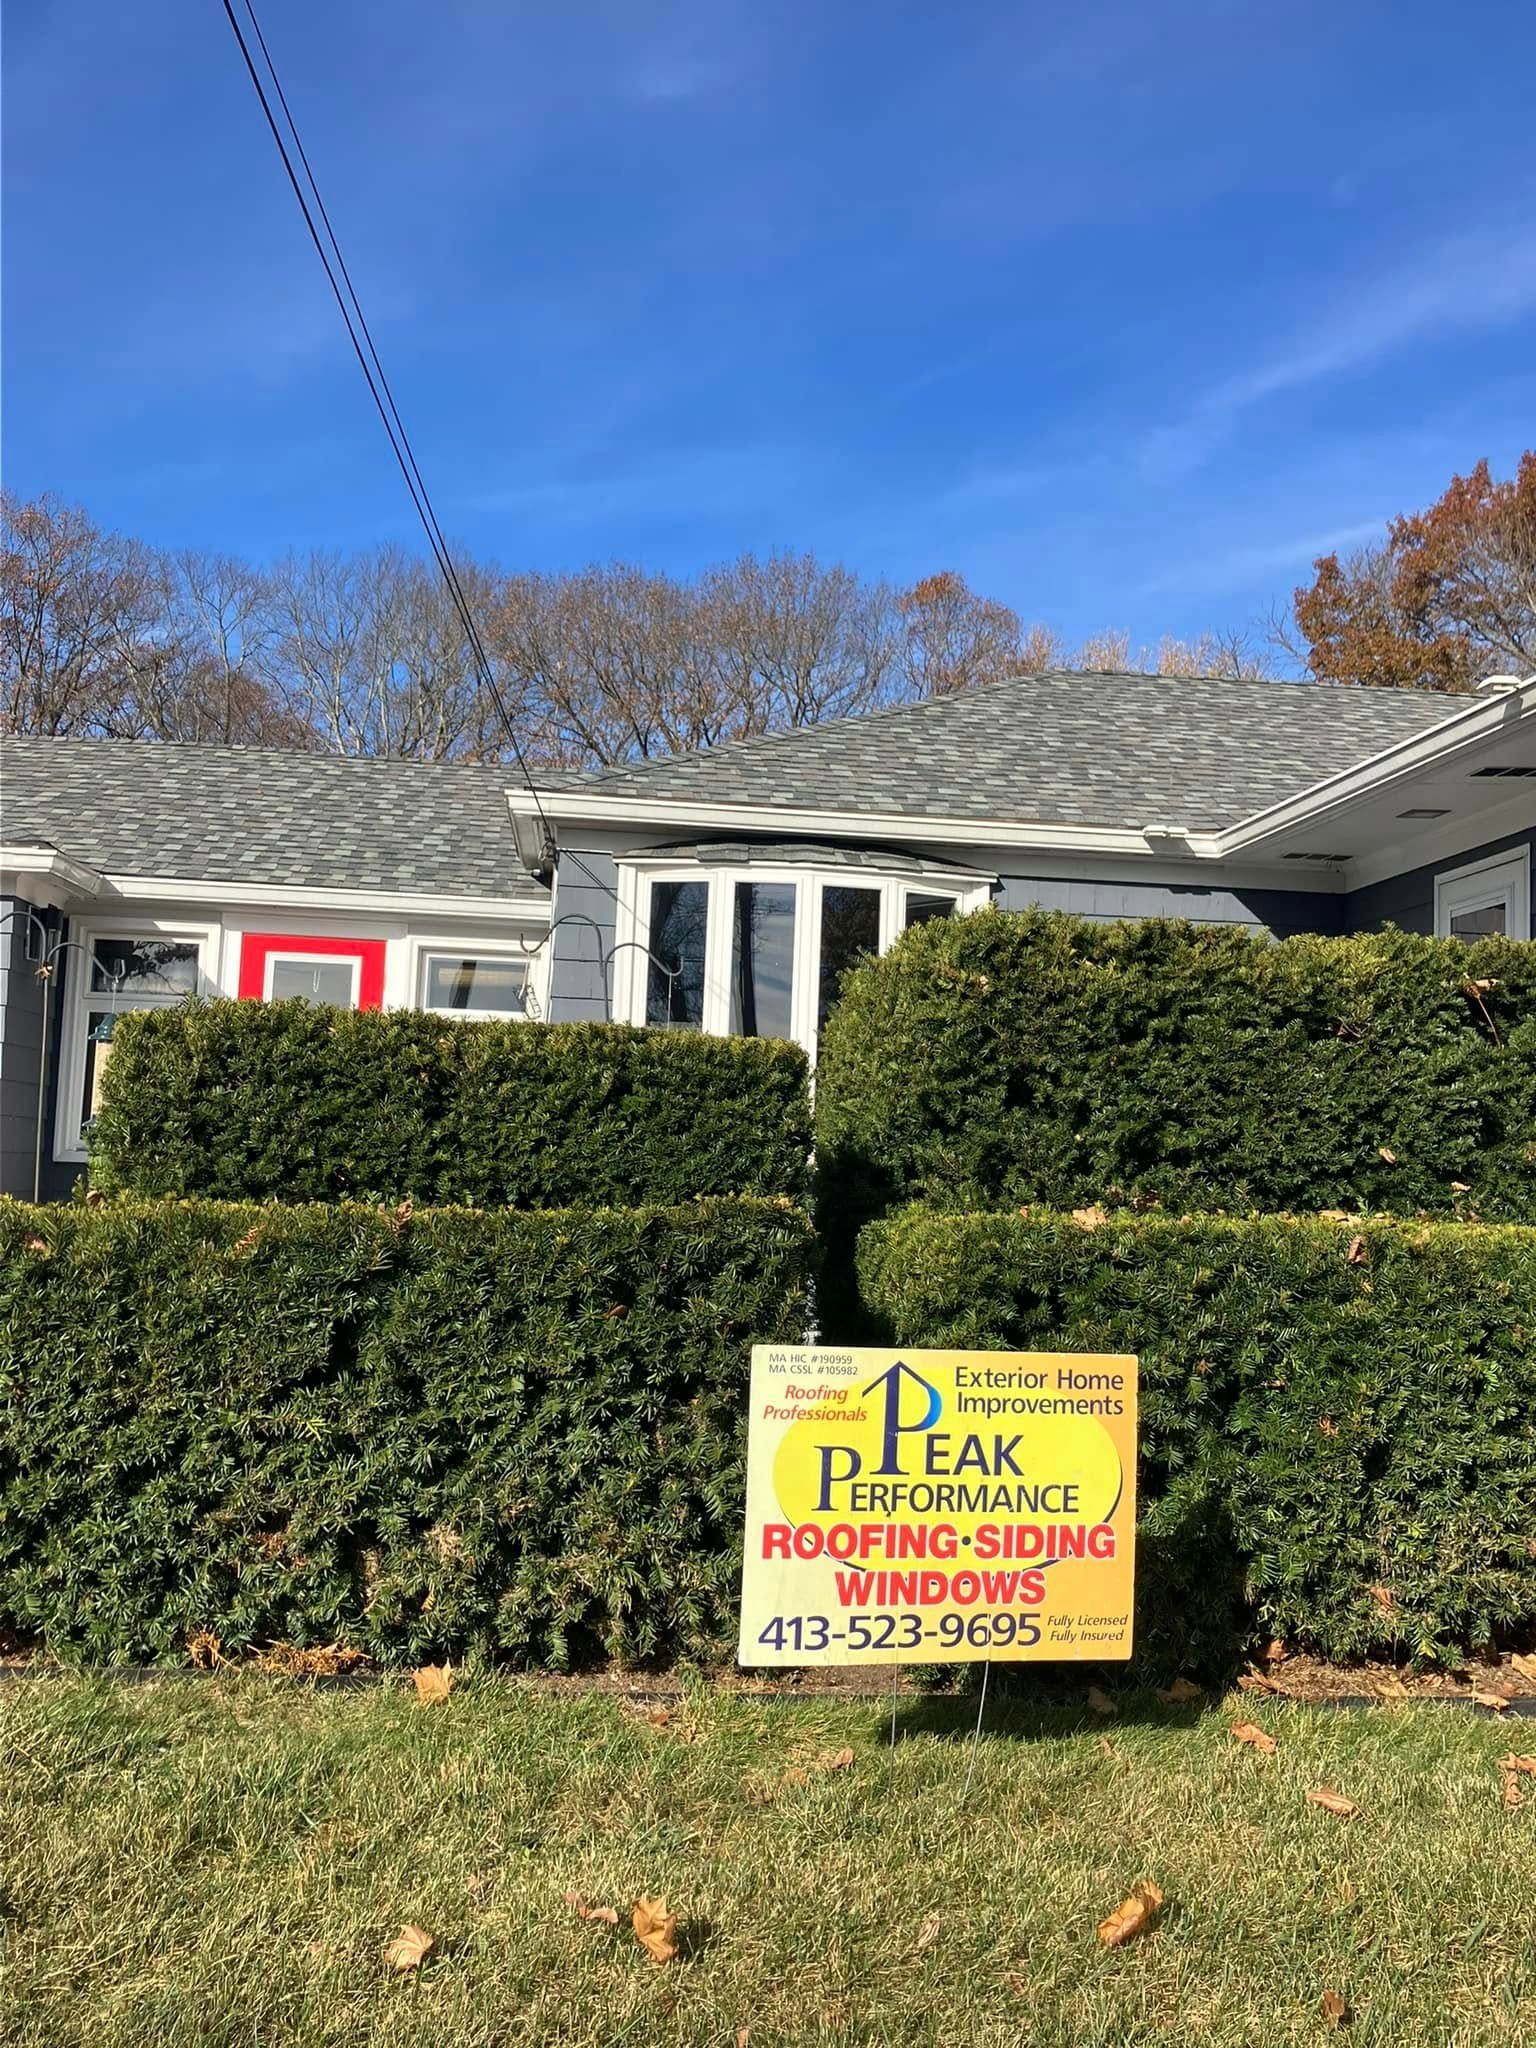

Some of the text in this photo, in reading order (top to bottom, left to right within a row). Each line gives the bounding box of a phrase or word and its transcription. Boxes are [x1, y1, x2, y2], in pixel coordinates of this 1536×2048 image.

[769, 1353, 853, 1365] MA HIC #190959
[769, 1365, 858, 1376] MA CSSL #105982
[955, 1366, 1123, 1390] Exterior Home
[784, 1385, 848, 1404] Roofing
[763, 1405, 867, 1422] Professionals
[957, 1392, 1123, 1419] Improvements
[862, 1361, 1024, 1476] PEAK
[811, 1445, 1079, 1513] PERFORMANCE
[834, 1571, 1046, 1607] WINDOWS
[1048, 1614, 1128, 1627] Fully Licensed
[758, 1613, 1041, 1651] 413-523-9695
[1050, 1630, 1123, 1642] Fully Insured
